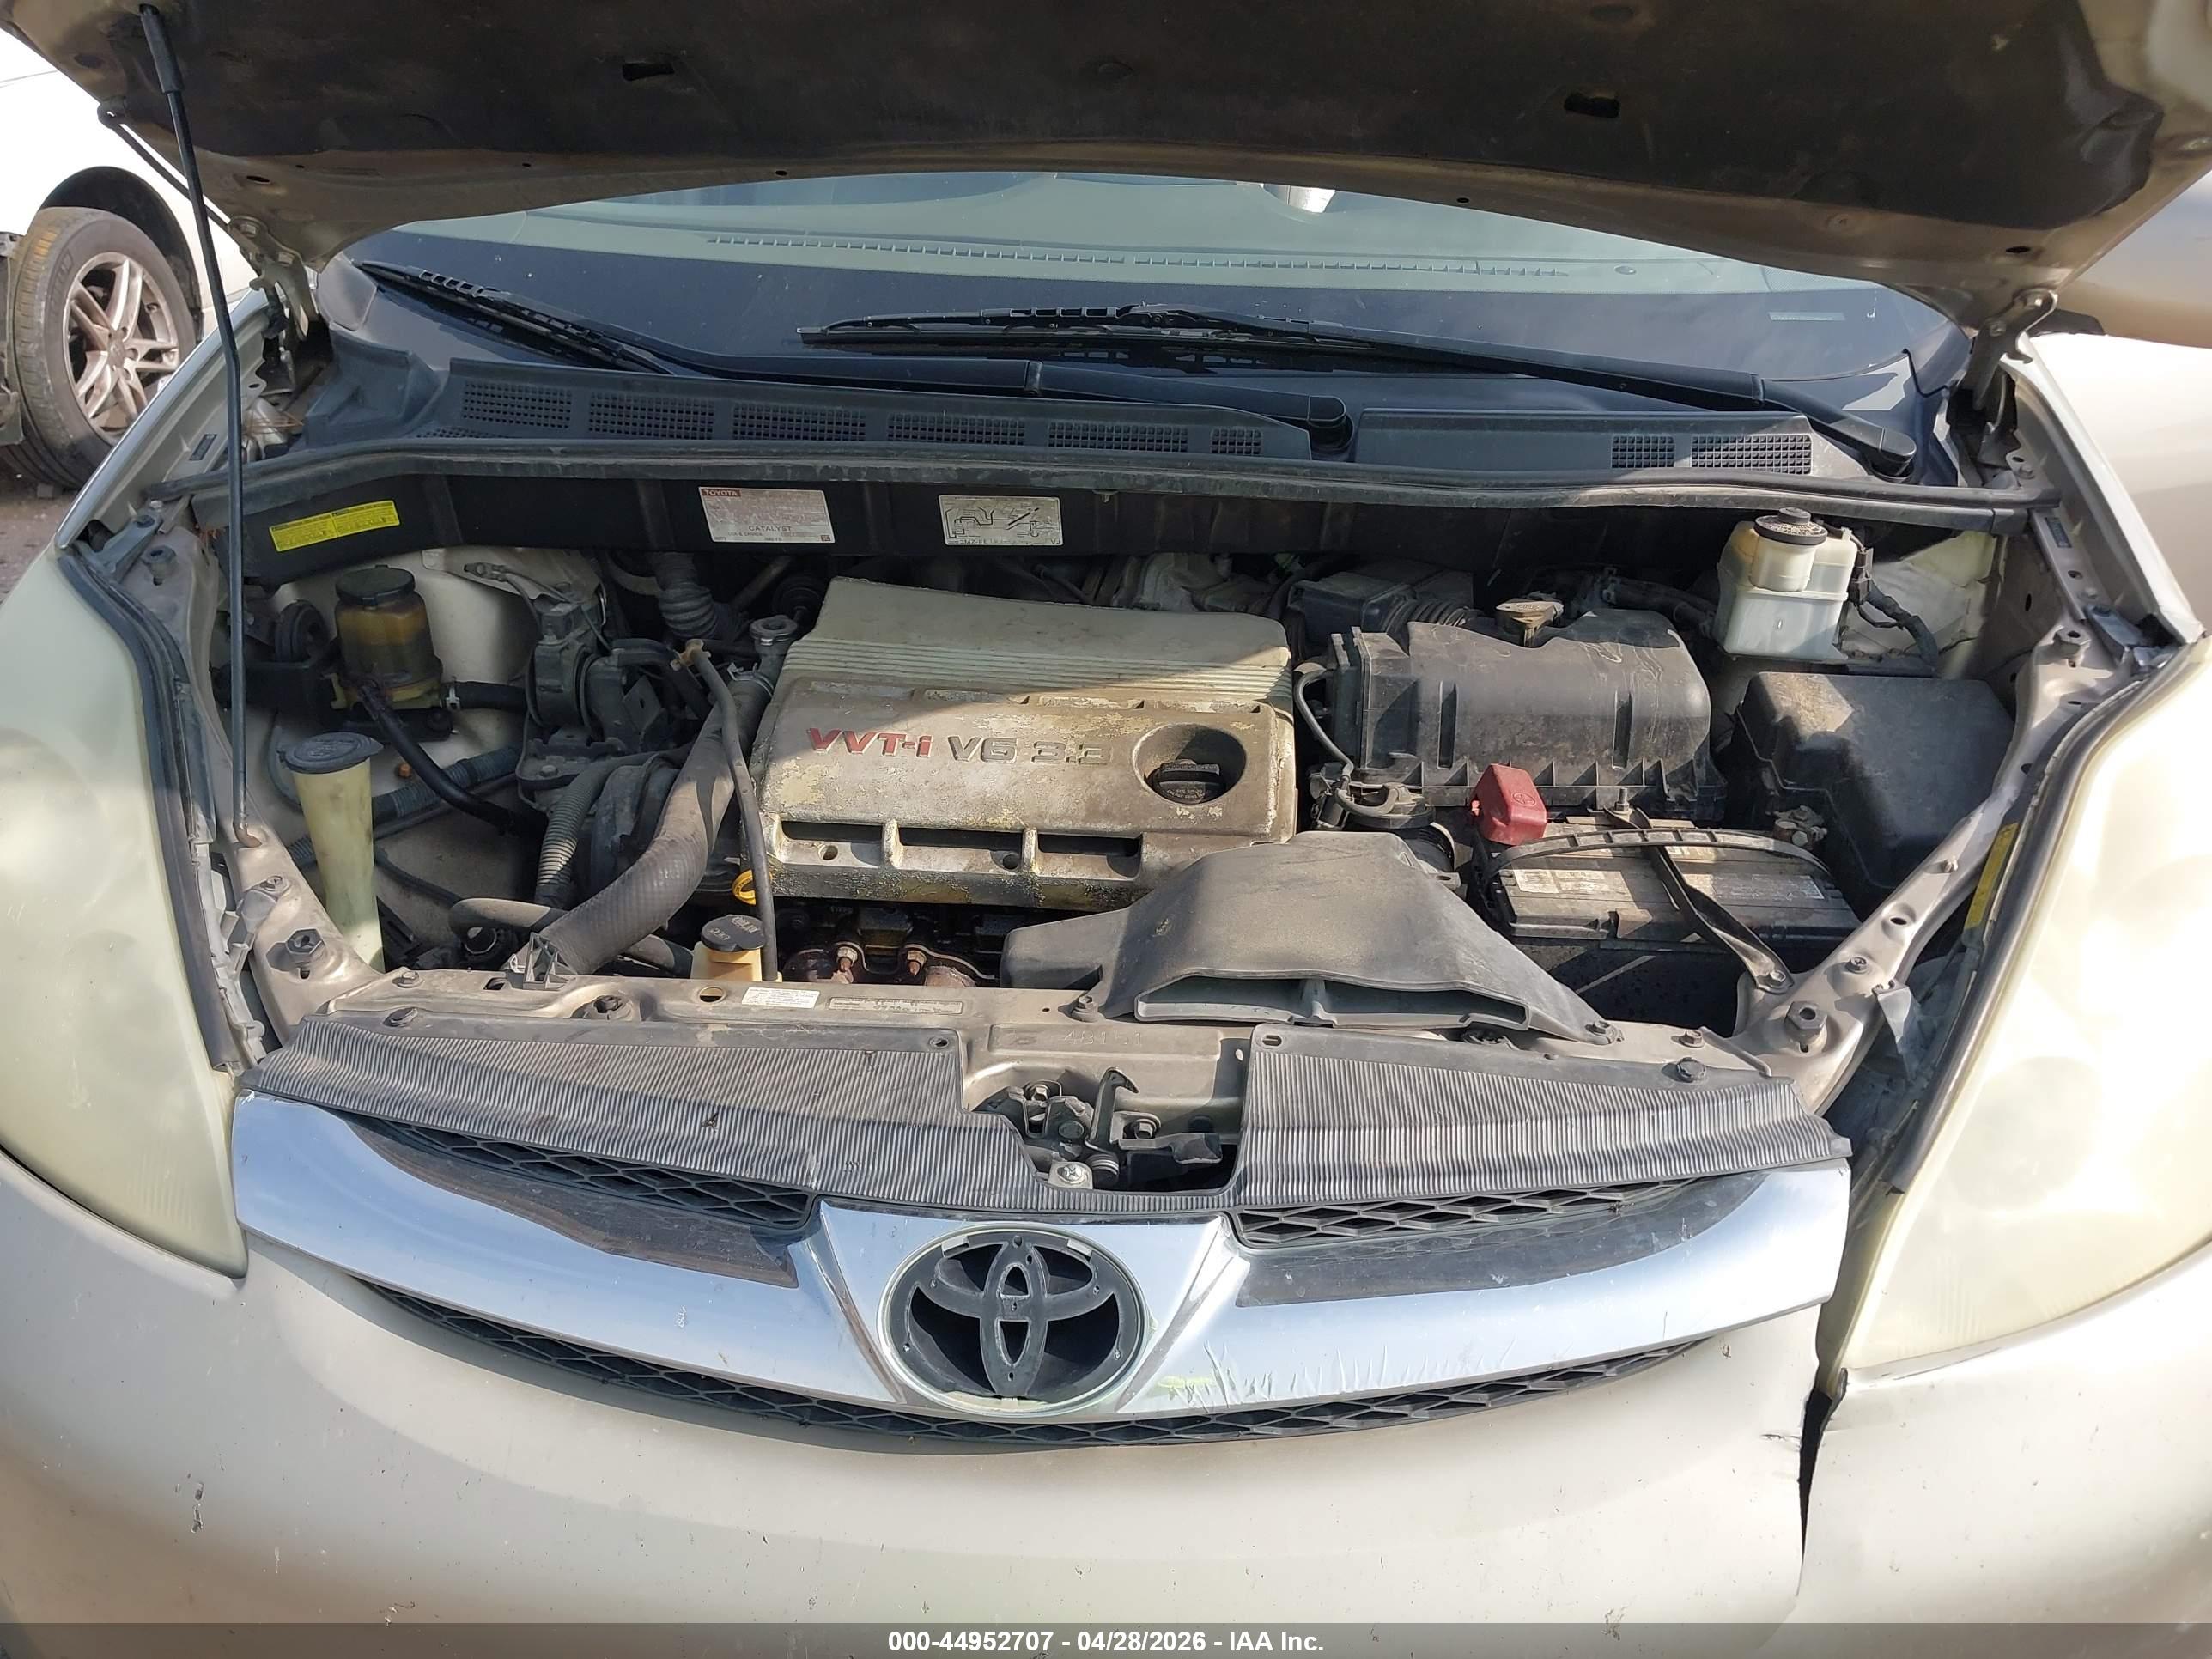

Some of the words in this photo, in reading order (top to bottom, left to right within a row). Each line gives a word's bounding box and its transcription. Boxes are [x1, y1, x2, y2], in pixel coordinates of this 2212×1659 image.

[809, 727, 933, 758] VVT-i
[947, 736, 1018, 763] V6
[1031, 740, 1114, 765] 3.3
